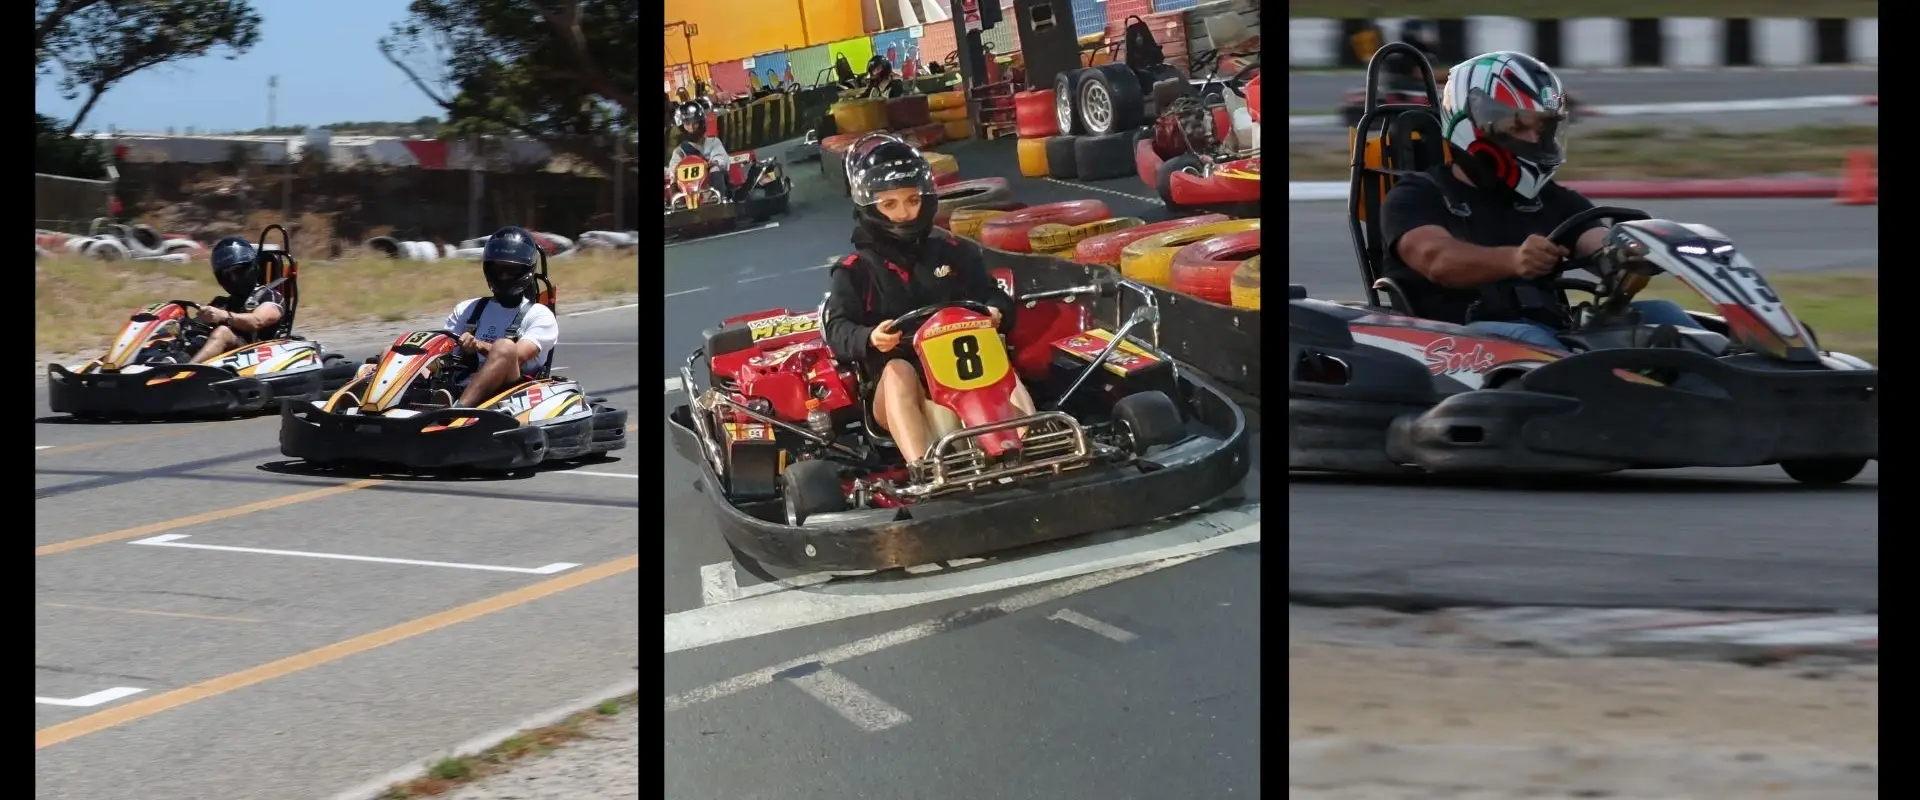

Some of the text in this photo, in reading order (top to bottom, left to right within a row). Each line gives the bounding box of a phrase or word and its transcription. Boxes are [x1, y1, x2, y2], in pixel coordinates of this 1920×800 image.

[683, 166, 700, 179] 18
[1714, 265, 1781, 305] 13
[952, 334, 984, 381] 8
[1422, 336, 1496, 376] Sodi
